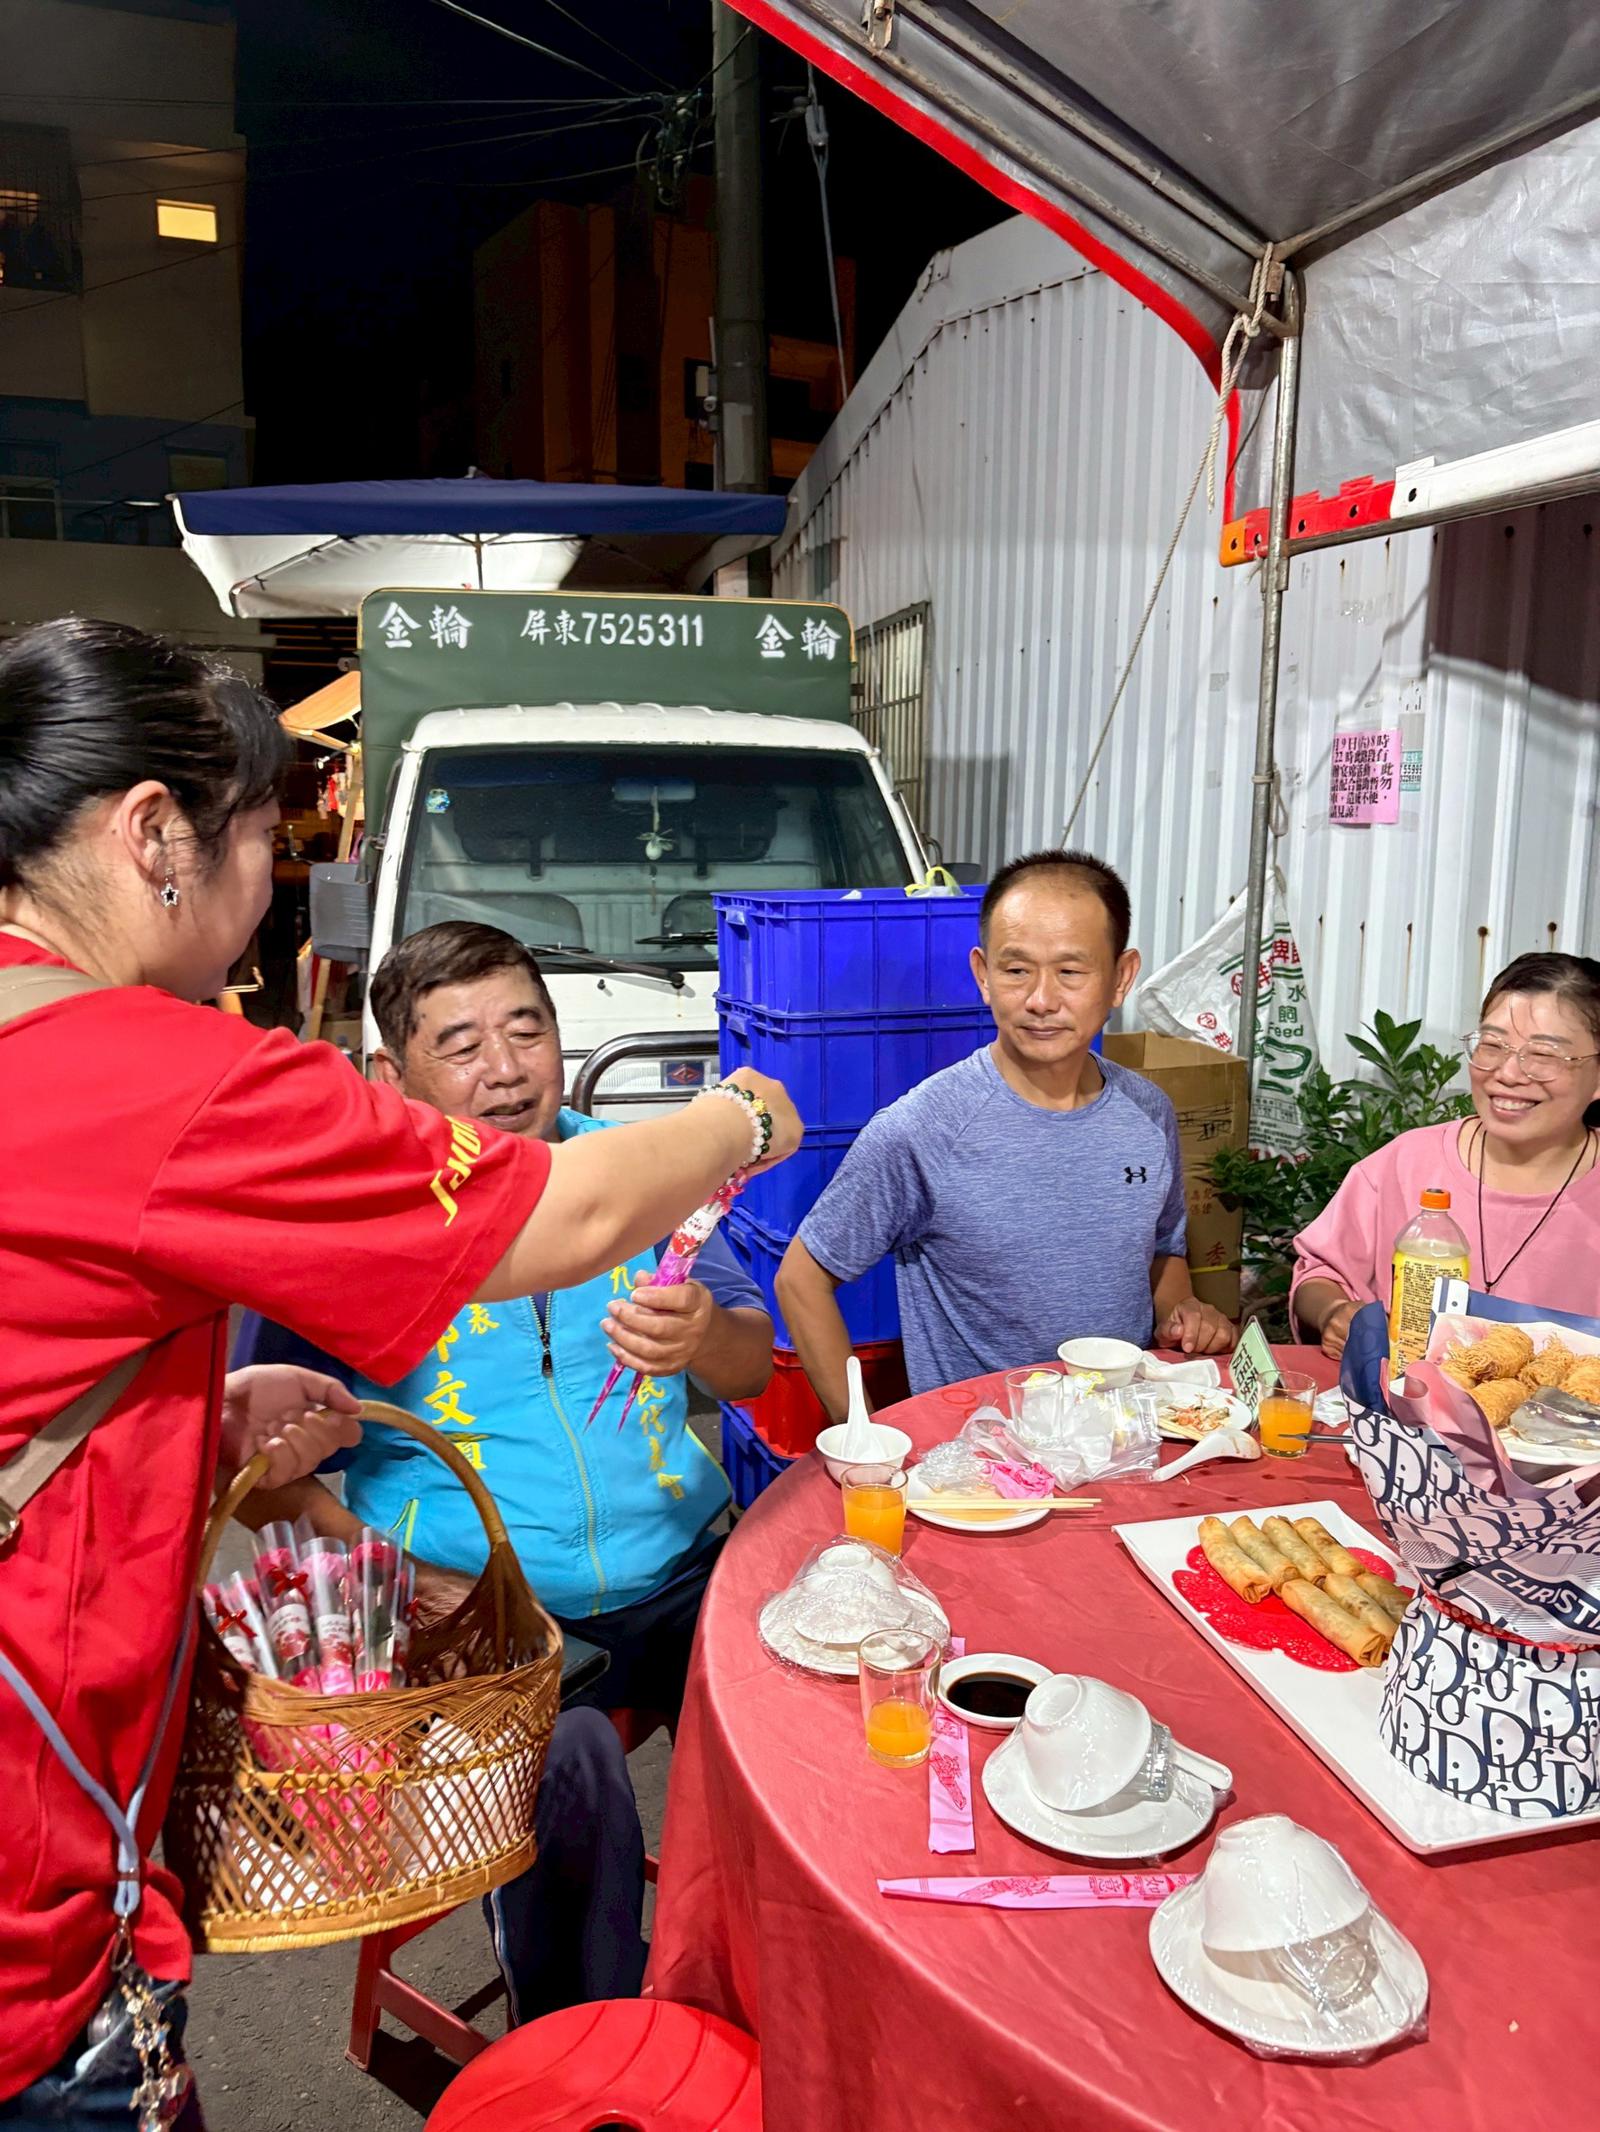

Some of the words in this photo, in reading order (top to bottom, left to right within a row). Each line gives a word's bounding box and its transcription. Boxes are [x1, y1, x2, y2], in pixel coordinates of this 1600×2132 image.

[377, 602, 473, 650] 金輪
[520, 608, 704, 648] 屏東7525311
[754, 613, 843, 662] 金輪
[1490, 1568, 1600, 1631] CHRISTI
